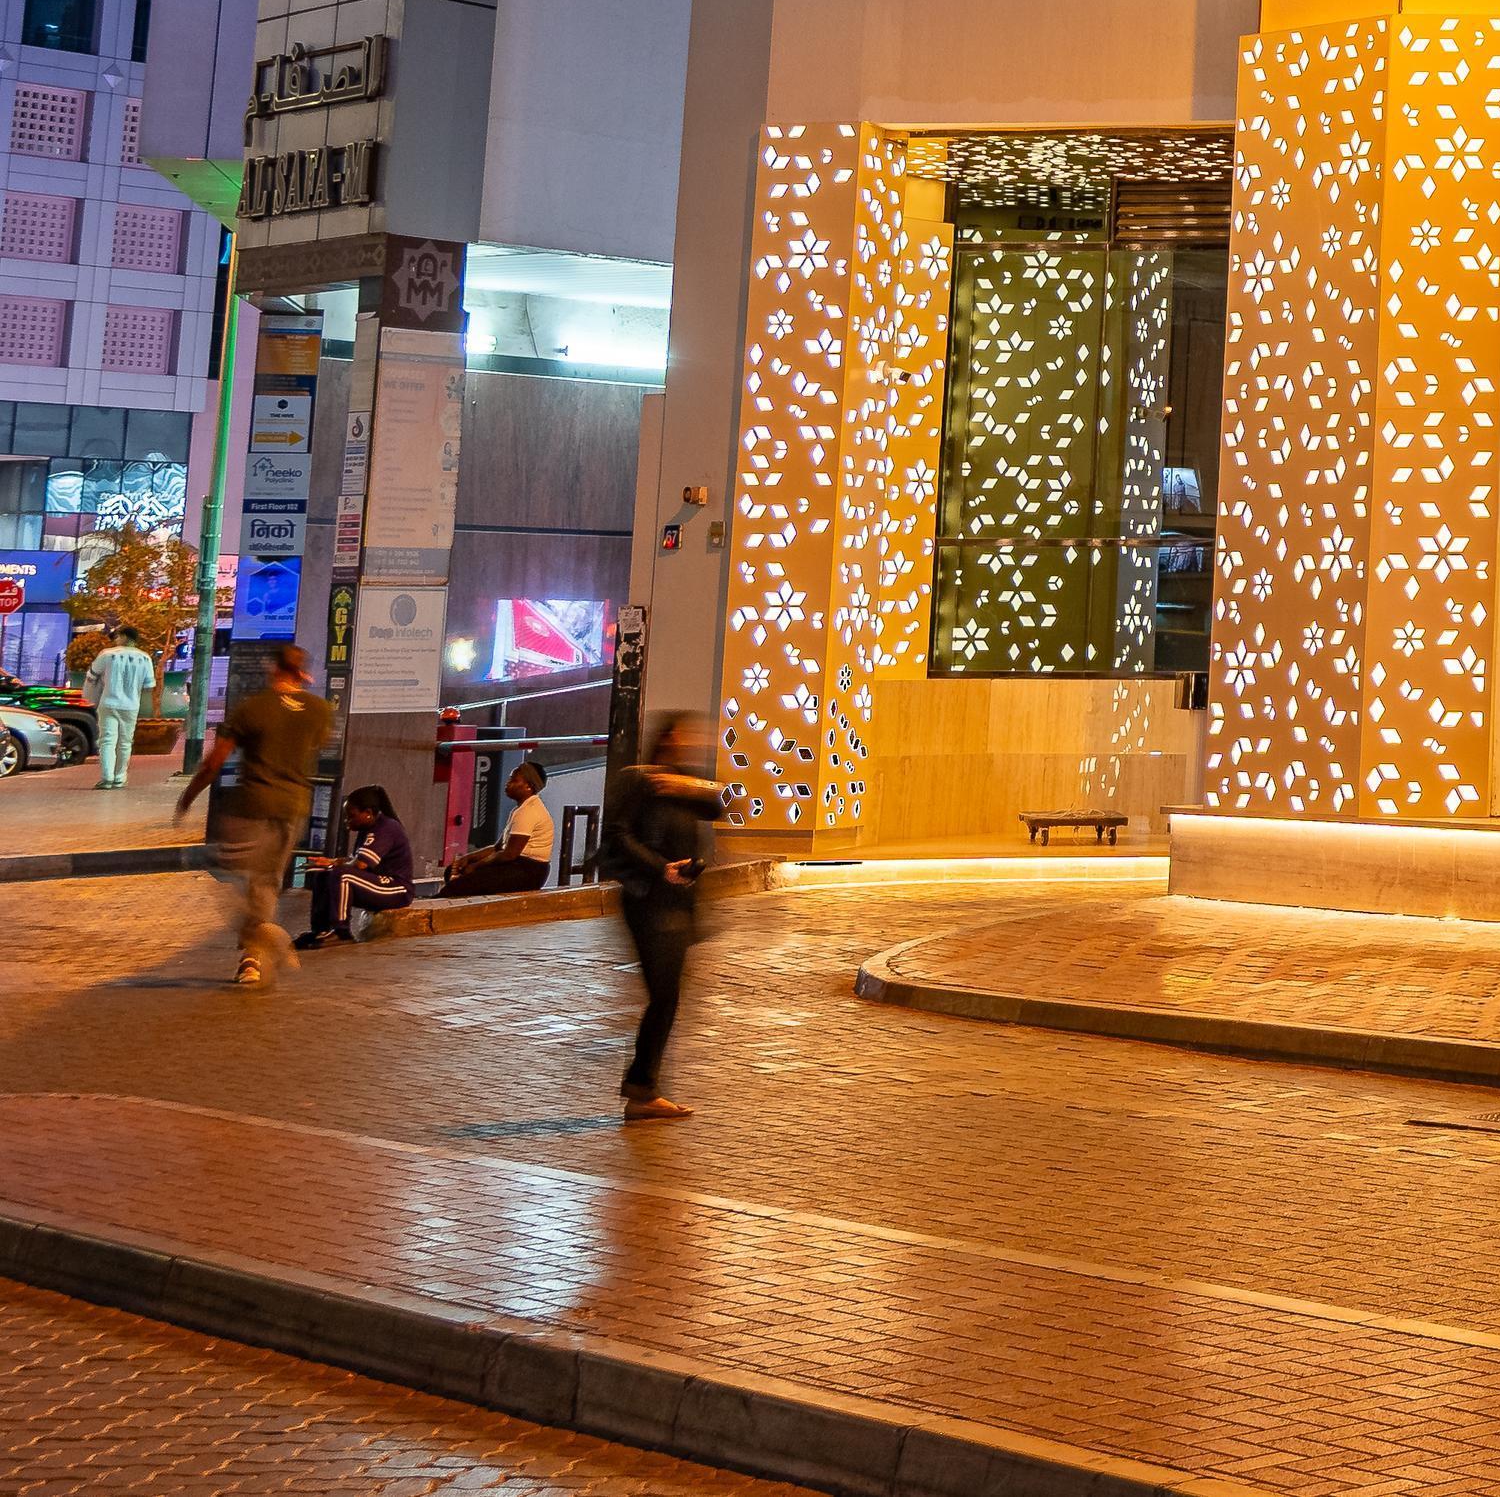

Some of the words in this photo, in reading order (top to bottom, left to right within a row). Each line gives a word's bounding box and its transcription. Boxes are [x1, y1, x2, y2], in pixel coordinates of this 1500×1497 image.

[236, 155, 267, 220] AL
[265, 467, 303, 478] neeko
[251, 503, 268, 511] First
[268, 503, 287, 511] Floor
[250, 518, 297, 539] निको
[0, 598, 19, 607] TOP
[330, 606, 348, 661] GYM
